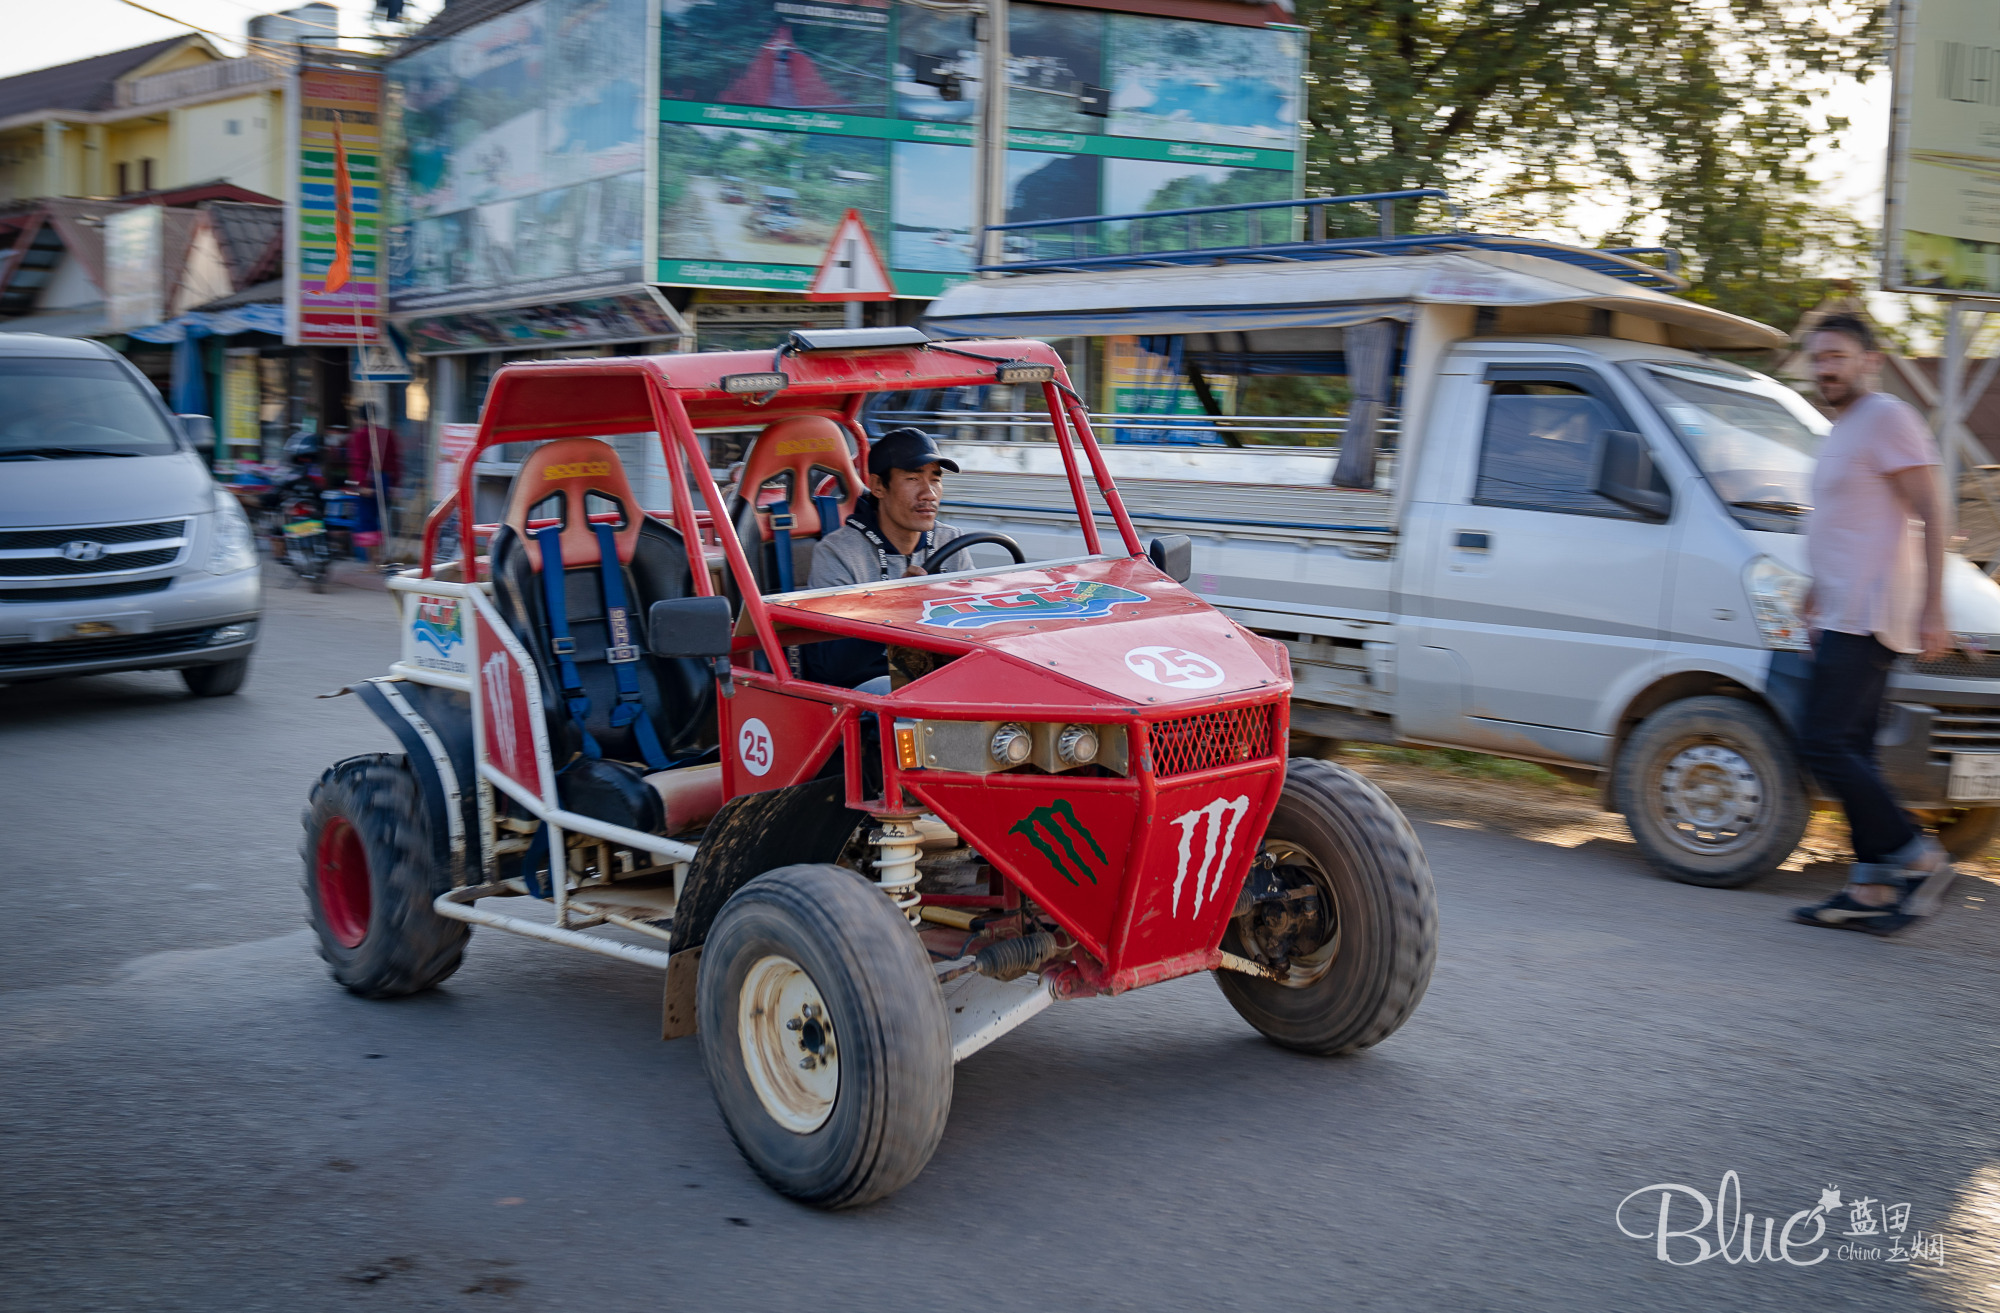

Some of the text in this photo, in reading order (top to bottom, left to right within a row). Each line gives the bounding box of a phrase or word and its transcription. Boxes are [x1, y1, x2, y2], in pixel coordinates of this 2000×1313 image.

[543, 461, 611, 478] sparco
[930, 583, 1081, 613] TCK
[1128, 649, 1218, 683] 25
[744, 730, 768, 767] 25
